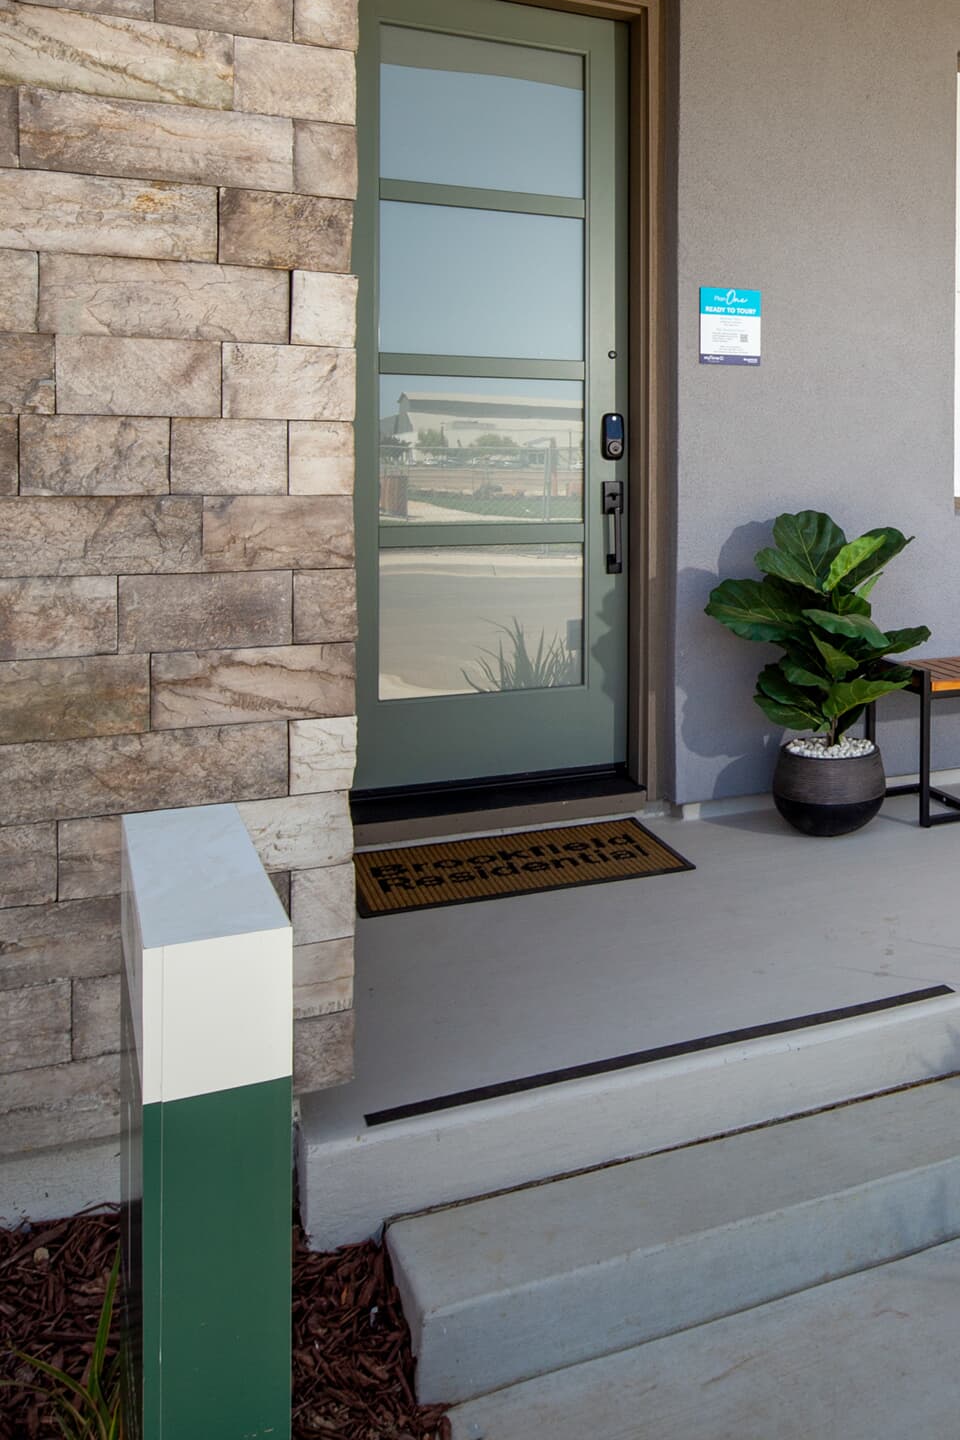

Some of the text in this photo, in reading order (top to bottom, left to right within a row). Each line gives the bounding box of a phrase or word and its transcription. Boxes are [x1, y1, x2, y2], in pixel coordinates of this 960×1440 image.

[726, 289, 748, 305] One
[370, 833, 636, 879] Brookfield
[377, 845, 650, 894] Residential
